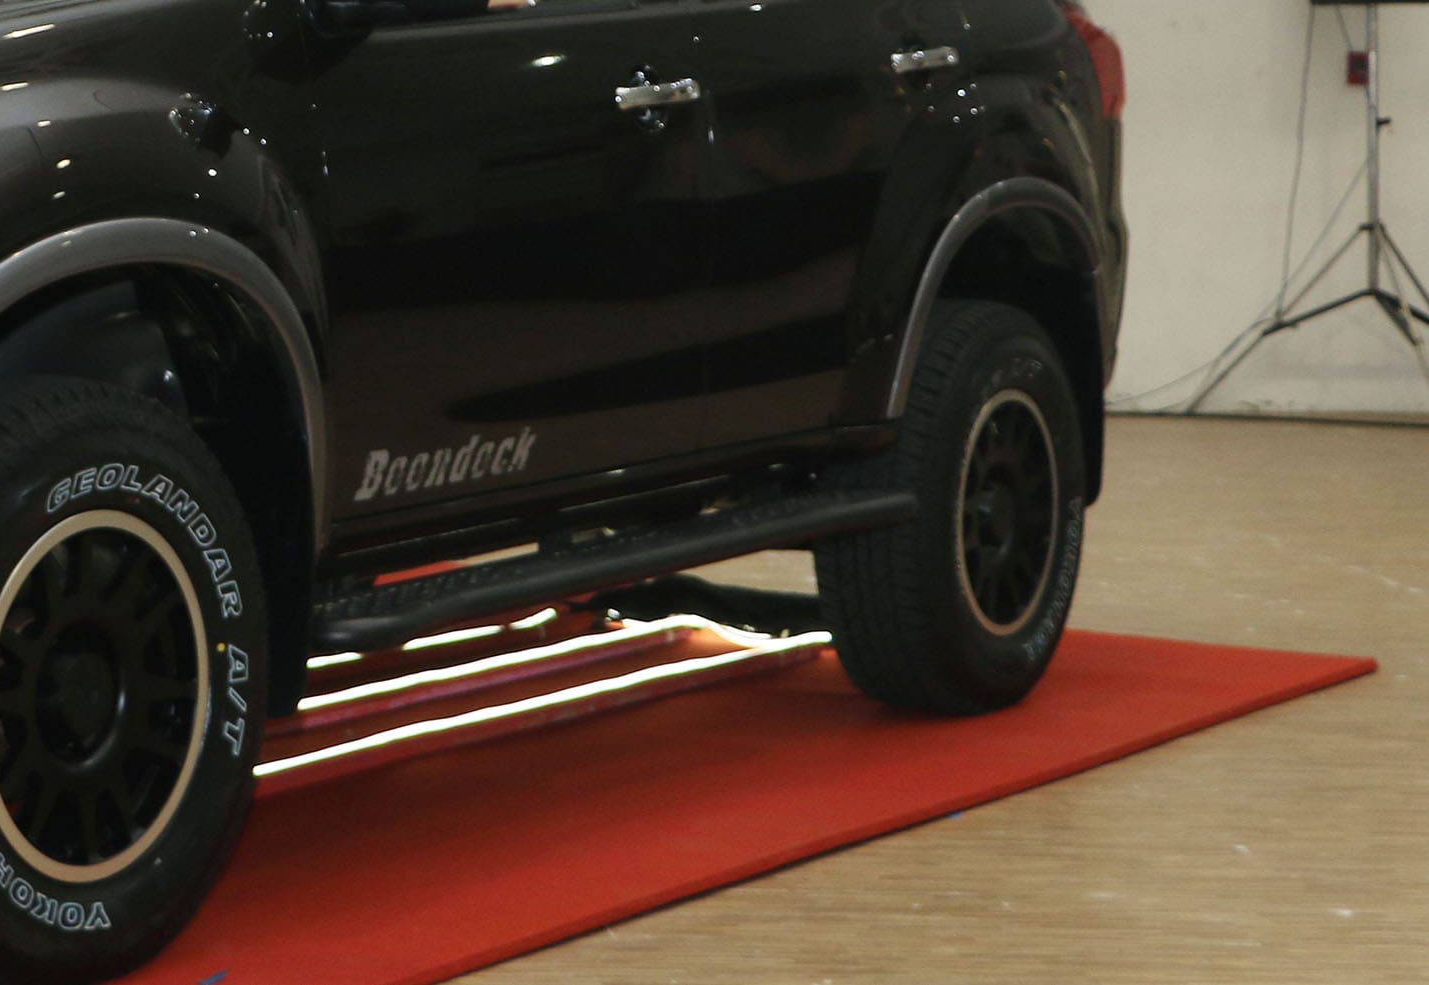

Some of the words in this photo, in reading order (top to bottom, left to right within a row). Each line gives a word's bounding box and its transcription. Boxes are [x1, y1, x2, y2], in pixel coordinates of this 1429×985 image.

[354, 426, 537, 501] Boondock
[47, 463, 243, 617] GEOLANDAR
[223, 644, 249, 757] A/T
